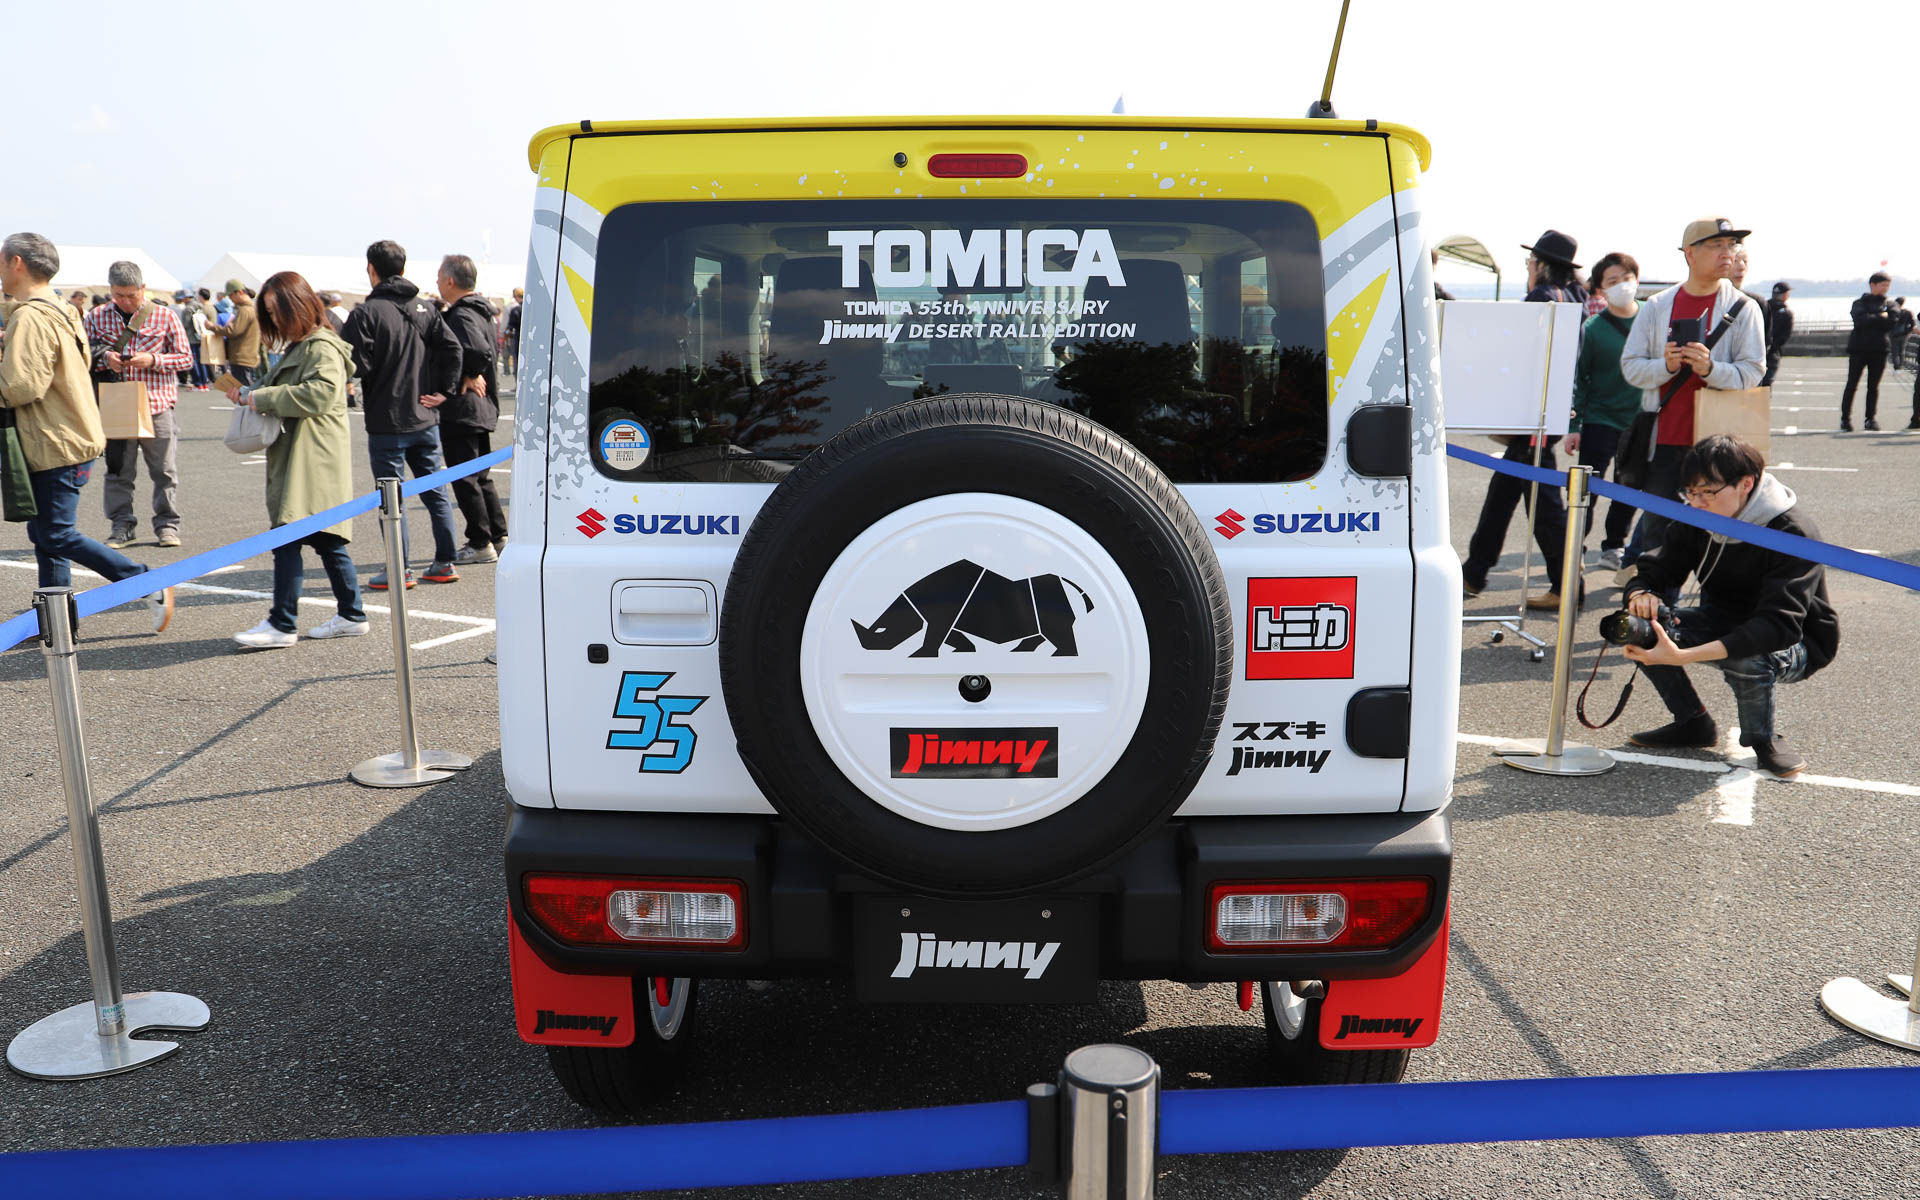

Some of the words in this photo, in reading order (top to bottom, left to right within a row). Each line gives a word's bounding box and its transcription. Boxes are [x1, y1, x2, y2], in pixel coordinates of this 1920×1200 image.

[827, 229, 1127, 288] TOMICA
[844, 301, 913, 316] TOMICA
[918, 300, 965, 316] 55th
[967, 300, 1110, 316] ANNIVERSARY
[819, 320, 904, 344] Jimny
[908, 323, 987, 338] DESERT
[989, 323, 1054, 338] RALLY
[1054, 323, 1137, 338] EDITION
[613, 514, 740, 535] SUZUKI
[1252, 512, 1380, 534] SUZUKI
[1252, 603, 1351, 653] トミカ
[606, 671, 711, 774] 55
[1232, 721, 1326, 741] スズキ
[900, 733, 1049, 774] Jimny
[1225, 747, 1332, 776] Jimny
[890, 932, 1061, 979] Jimny
[533, 1010, 618, 1036] Jimny
[1334, 1015, 1424, 1040] Jimny
